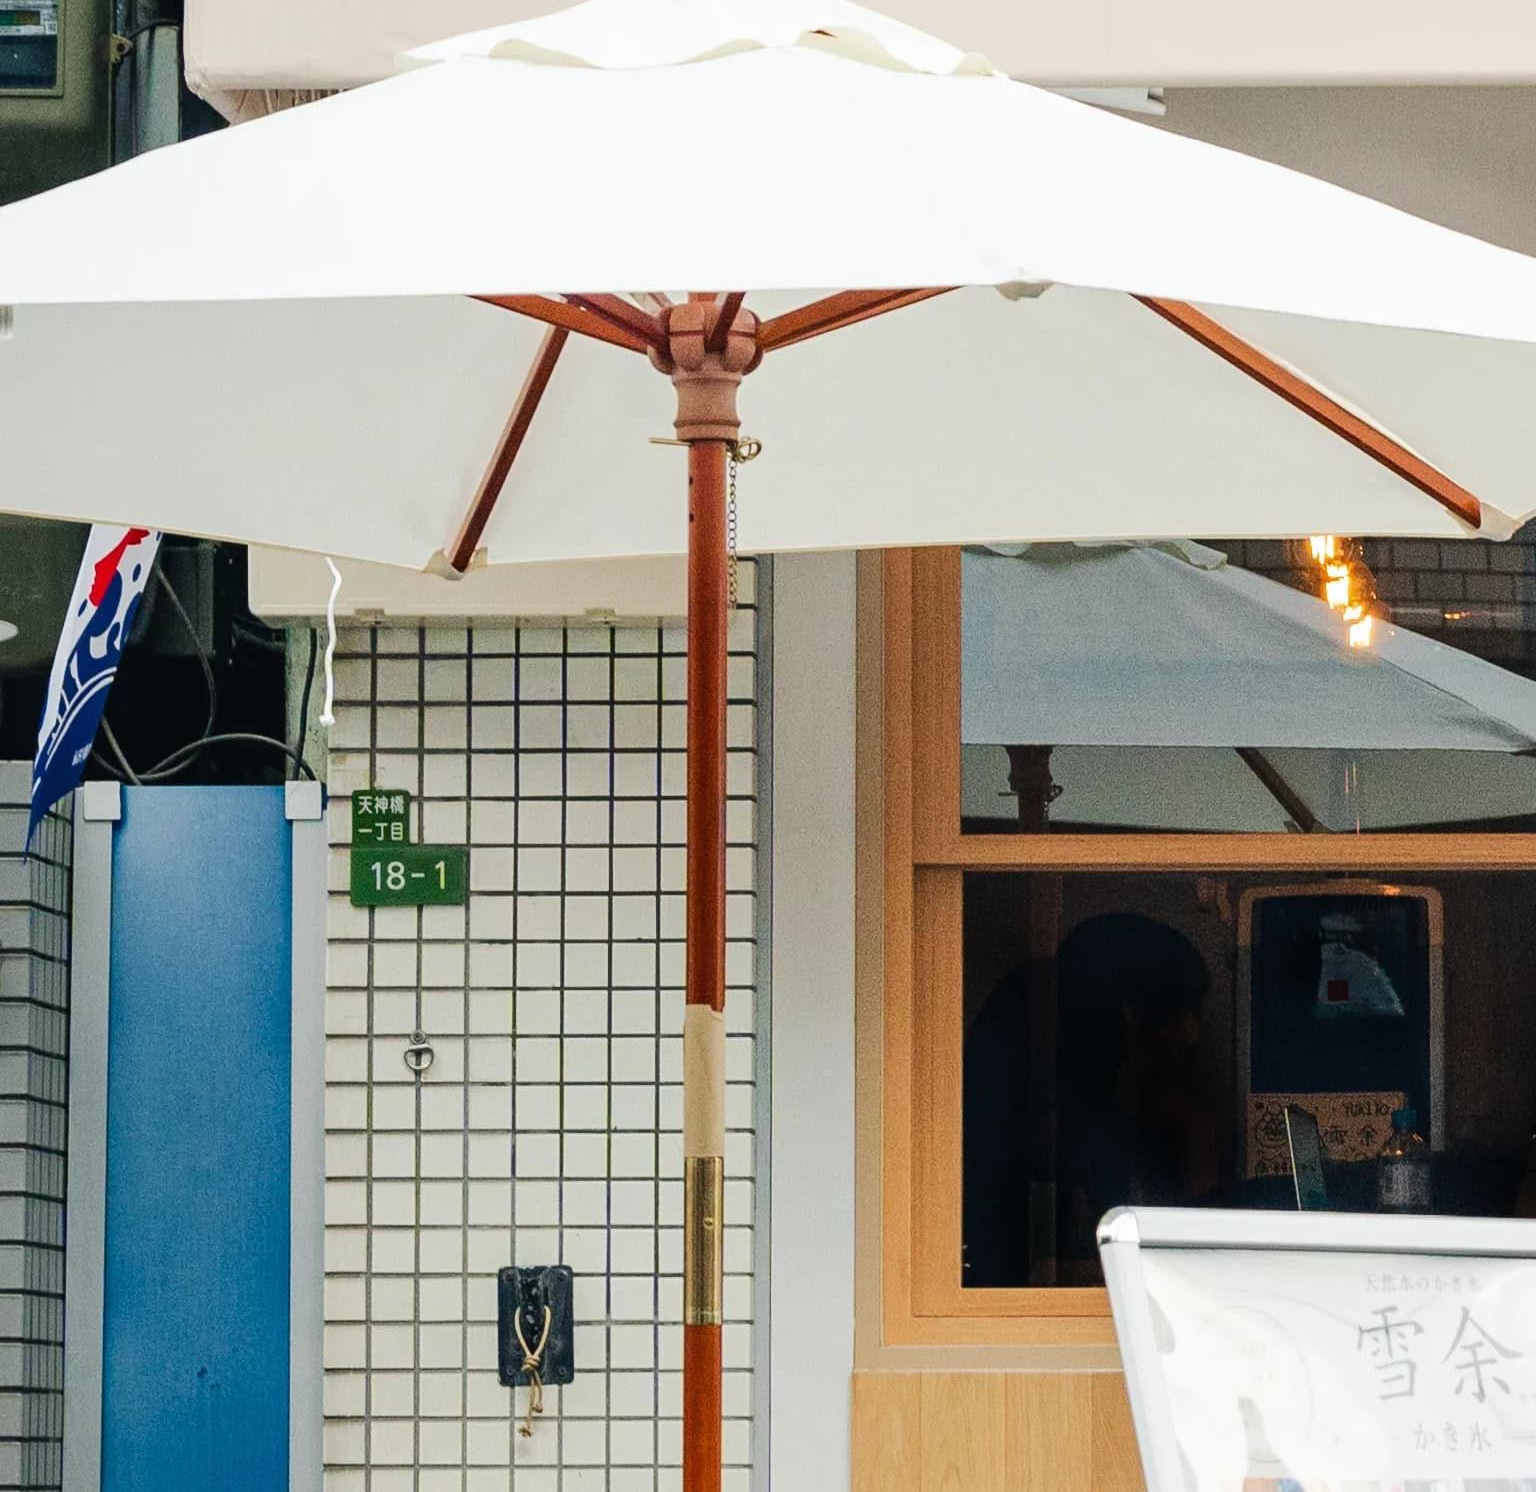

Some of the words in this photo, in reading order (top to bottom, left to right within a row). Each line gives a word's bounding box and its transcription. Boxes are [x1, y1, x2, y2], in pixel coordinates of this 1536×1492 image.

[357, 795, 405, 815] 天神橋
[357, 822, 404, 842] 一丁目
[371, 861, 446, 891] 18-1
[1357, 1305, 1524, 1404] 雪余
[1413, 1421, 1493, 1451] かき氷
